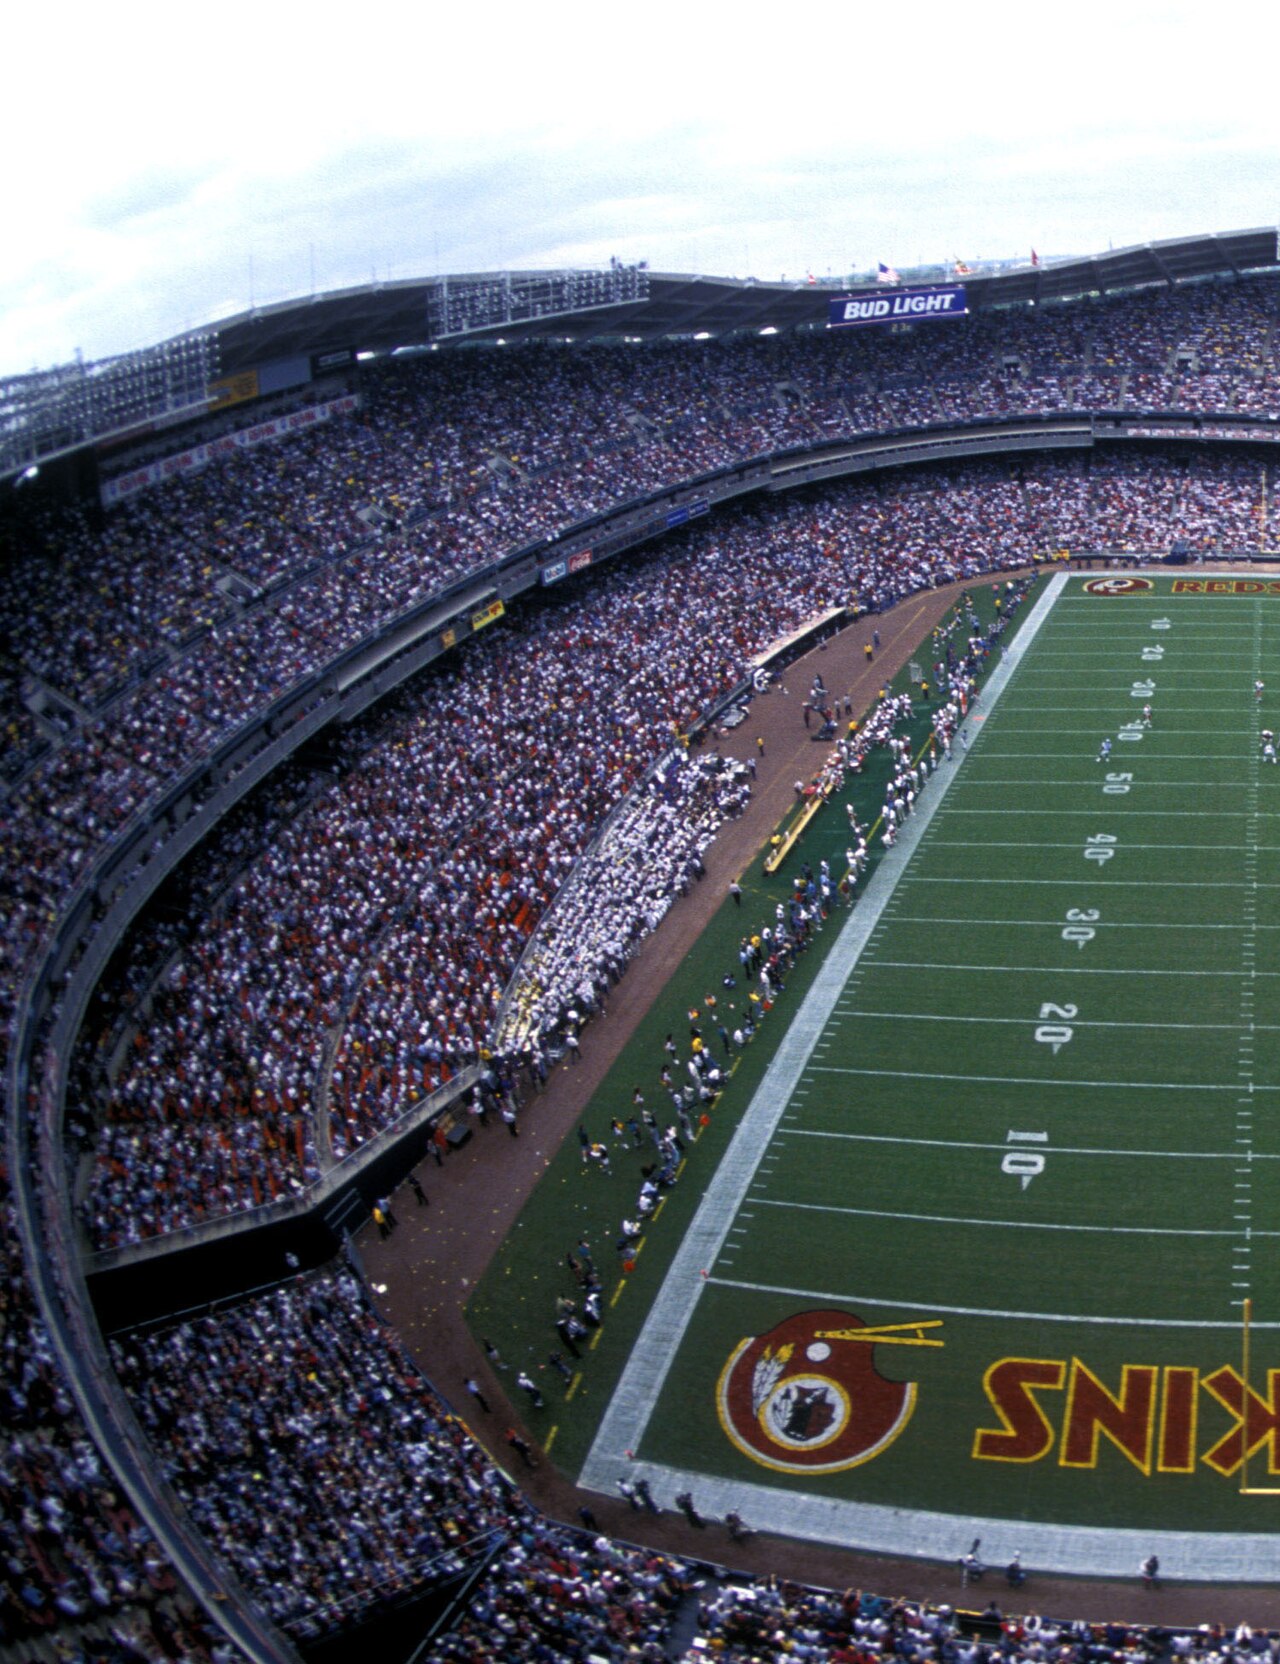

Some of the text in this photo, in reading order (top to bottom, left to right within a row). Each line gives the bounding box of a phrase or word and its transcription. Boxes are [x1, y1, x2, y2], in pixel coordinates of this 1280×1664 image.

[843, 293, 955, 320] BUD LIGHT
[1102, 773, 1133, 794] 50
[1084, 833, 1118, 859] 40
[1062, 908, 1100, 941] 30
[1034, 1002, 1079, 1043] 20
[1001, 1130, 1049, 1176] 10
